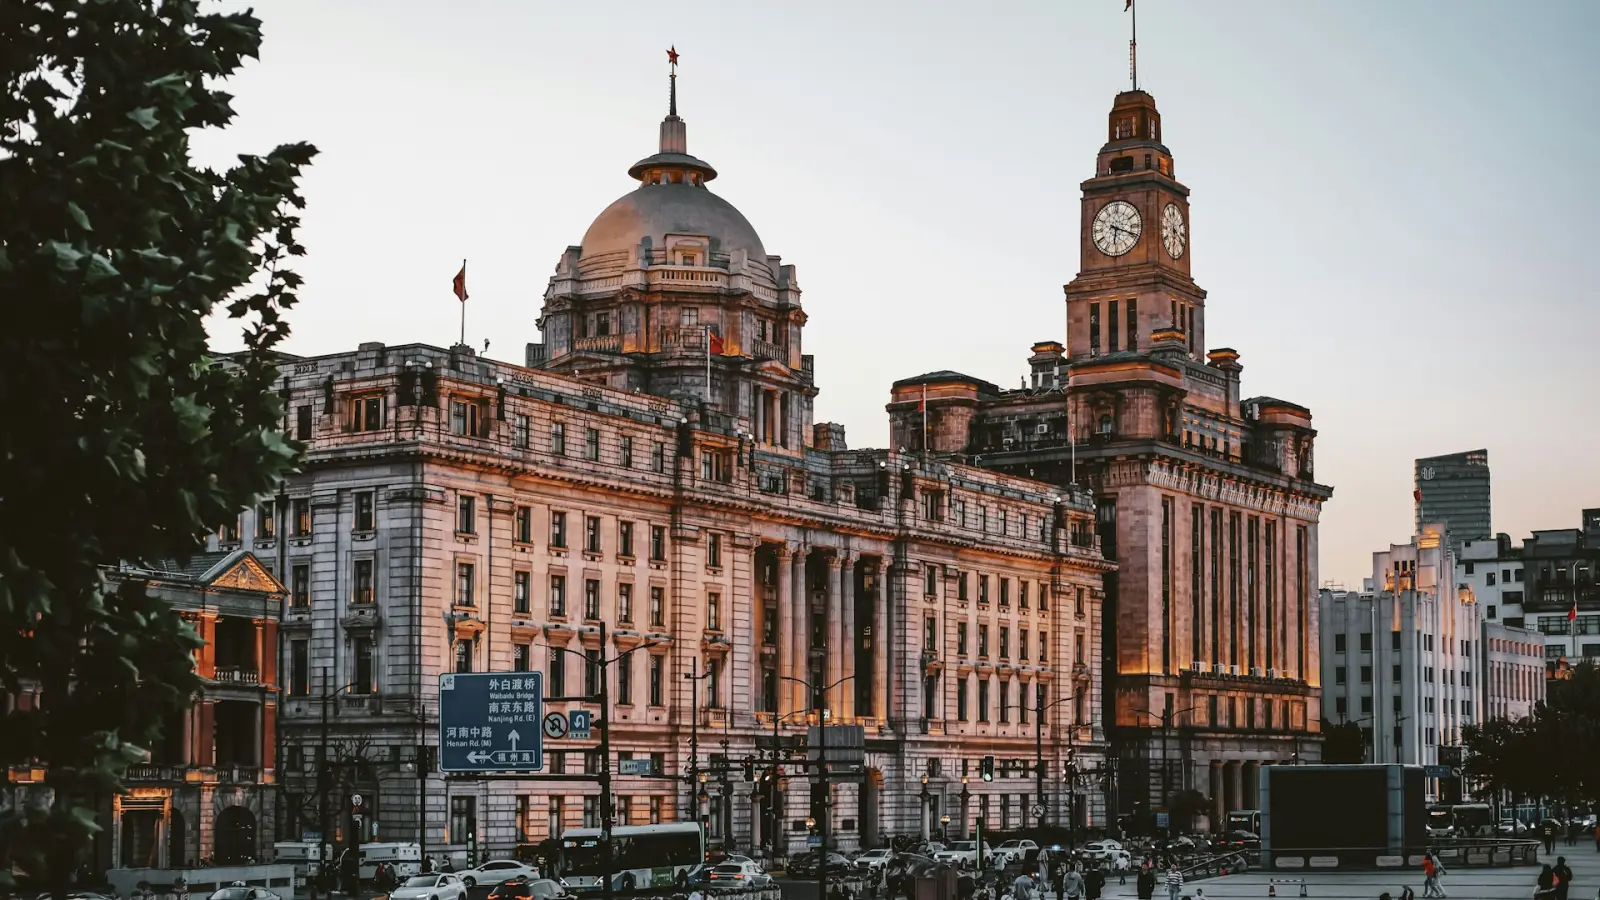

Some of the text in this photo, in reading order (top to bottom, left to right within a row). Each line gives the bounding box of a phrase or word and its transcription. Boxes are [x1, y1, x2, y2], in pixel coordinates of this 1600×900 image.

[489, 678, 535, 691] 外白渡桥
[516, 692, 534, 700] Bridge
[488, 701, 535, 713] 南京东路
[446, 726, 492, 738] 河南中路
[498, 752, 531, 761] 福州路
